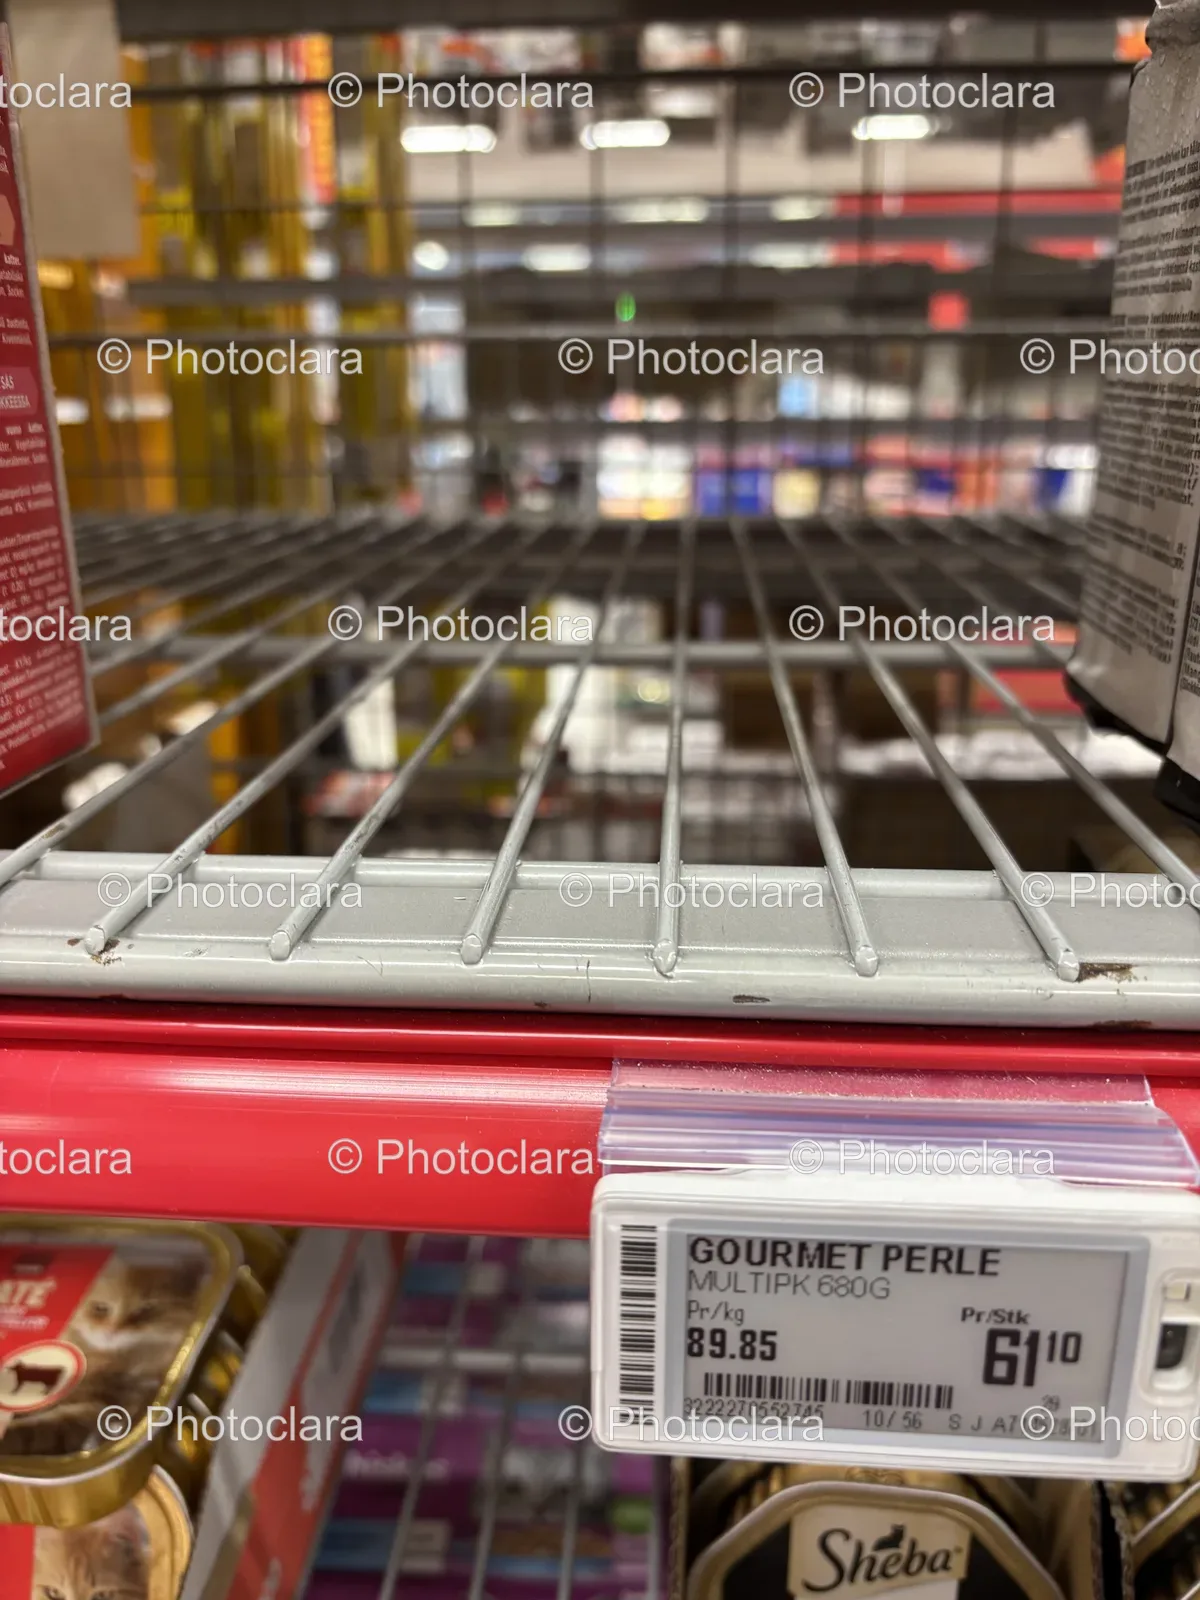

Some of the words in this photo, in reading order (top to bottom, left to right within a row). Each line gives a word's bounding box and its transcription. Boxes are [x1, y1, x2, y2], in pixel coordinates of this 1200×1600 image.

[688, 1236, 872, 1271] GOURMET
[882, 1244, 1002, 1276] PERLE
[687, 1270, 811, 1296] MULTIPK
[817, 1274, 891, 1300] 680G
[687, 1300, 745, 1326] Pr/kg
[960, 1306, 1031, 1325] Pr/Stk
[687, 1327, 777, 1361] 89.85
[802, 1528, 953, 1592] Sheba
